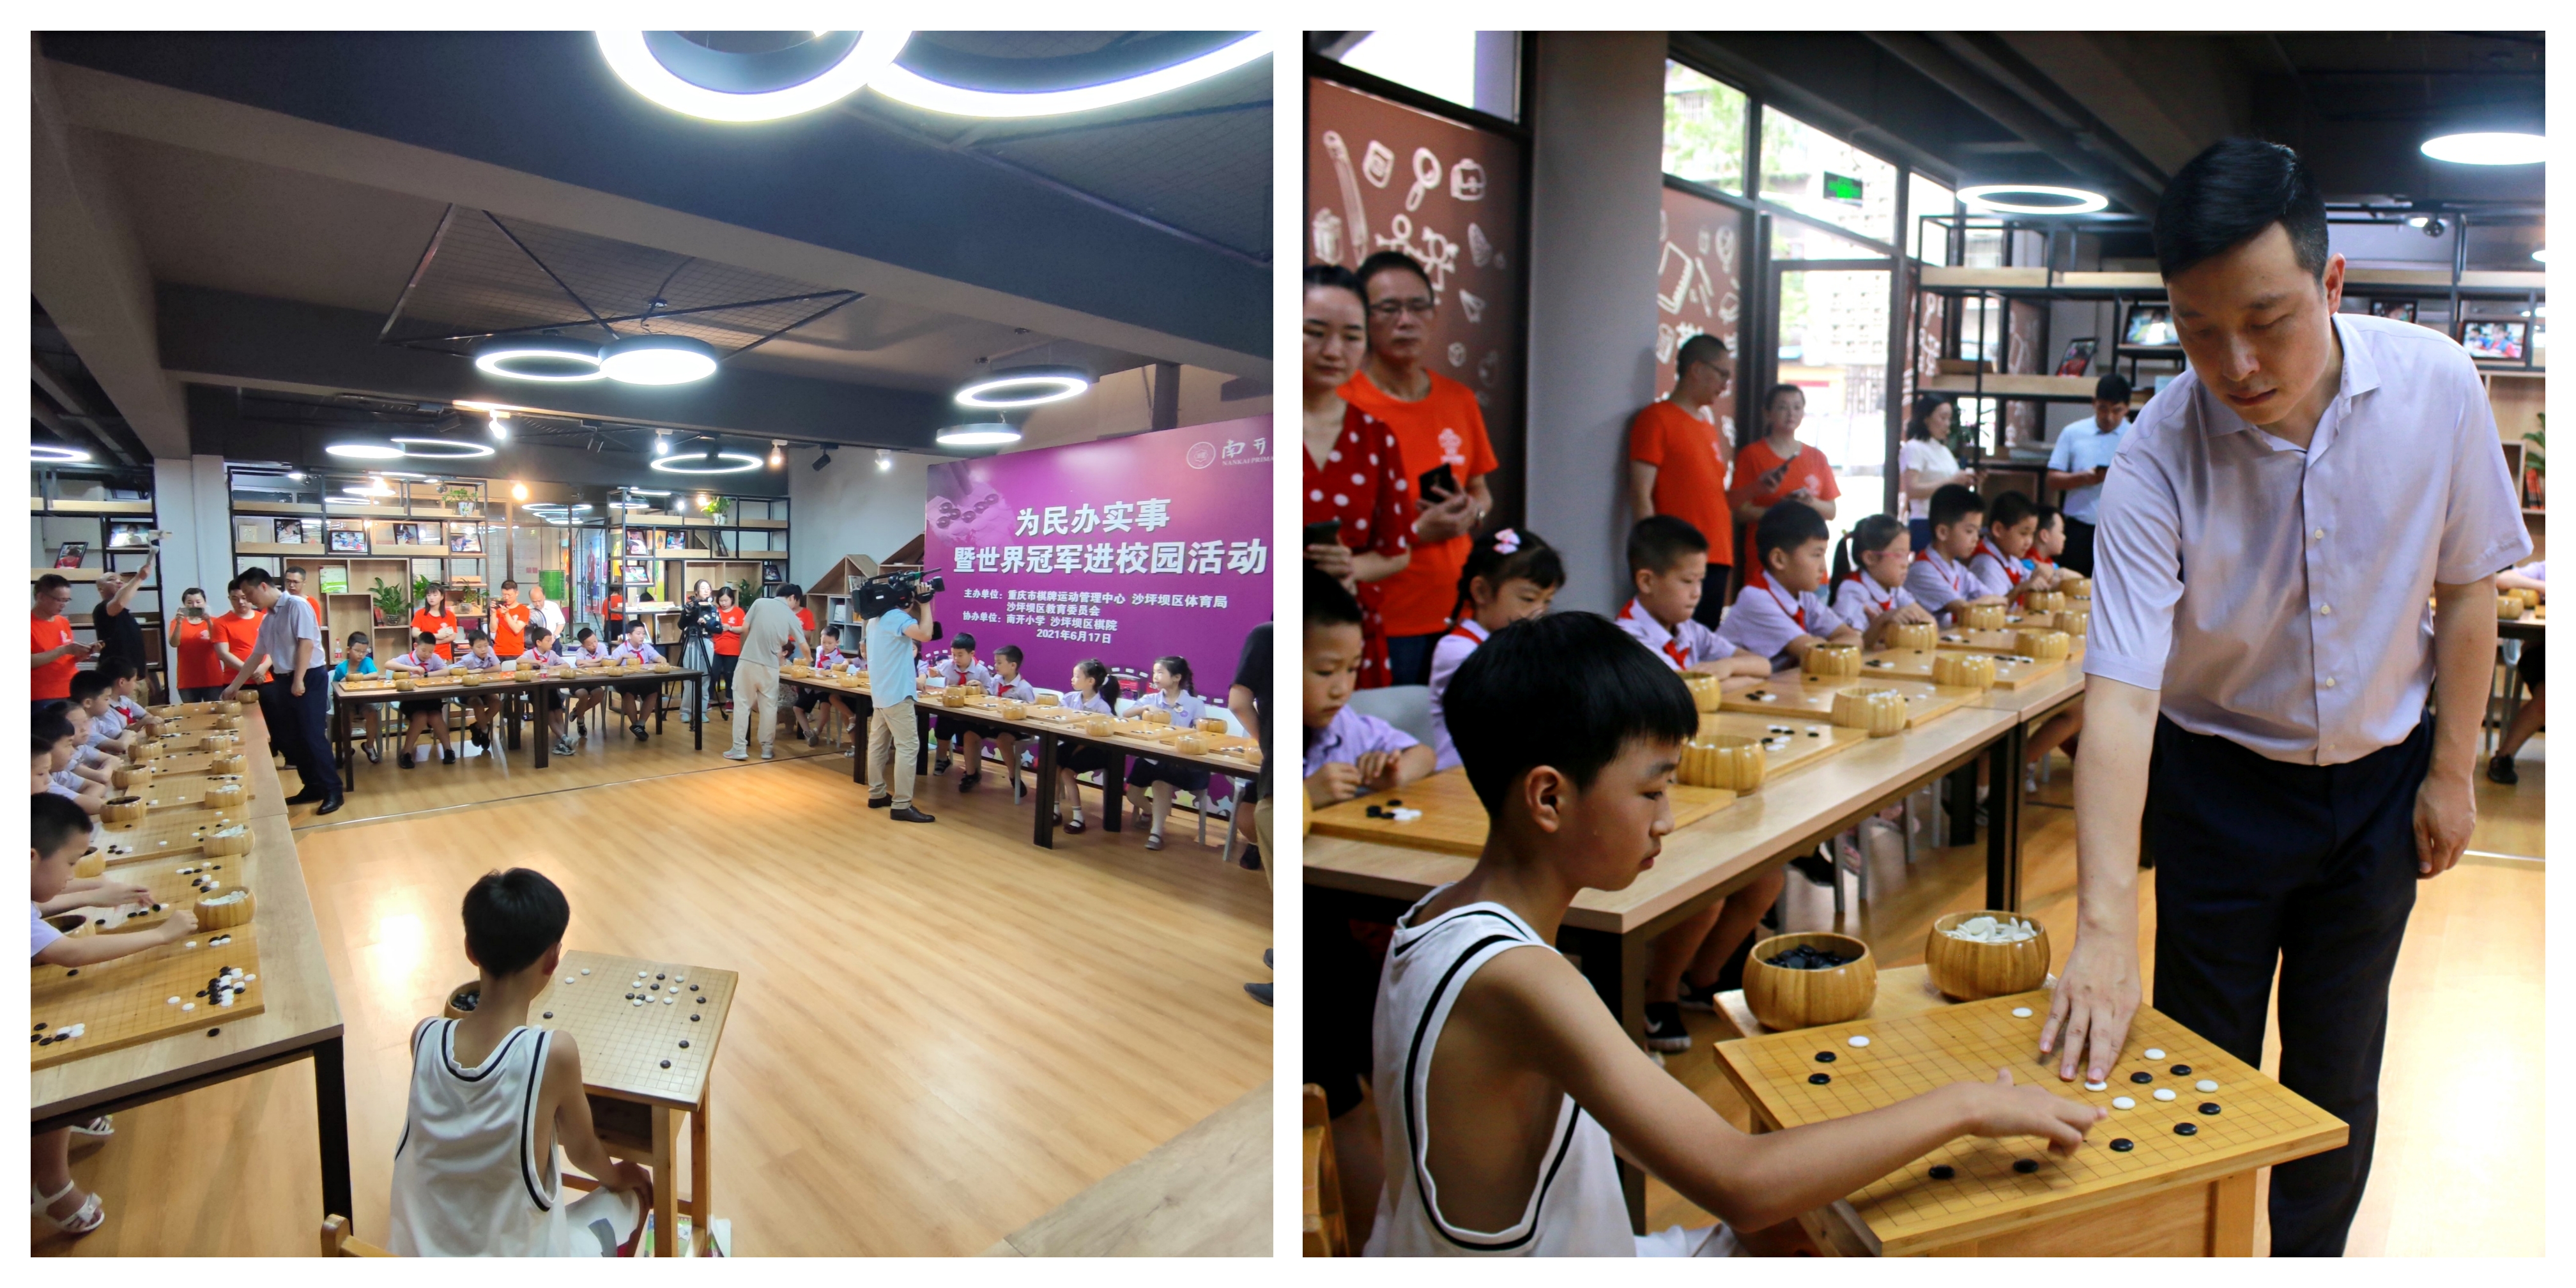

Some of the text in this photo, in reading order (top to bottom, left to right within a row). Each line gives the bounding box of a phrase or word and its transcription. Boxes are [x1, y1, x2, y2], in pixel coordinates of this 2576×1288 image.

[1015, 498, 1172, 537] 为民办实事
[953, 538, 1268, 575] 暨世界冠军进校园活动
[963, 588, 1229, 610] 主办单位： 重庆市棋牌运动管理中心 沙坪坝区体育局
[1006, 602, 1101, 617] 沙坪坝区教育委员会
[962, 611, 1118, 632] 协办单位： 南开小学 沙坪坝区棋院
[1036, 629, 1112, 644] 2021年6月17日
